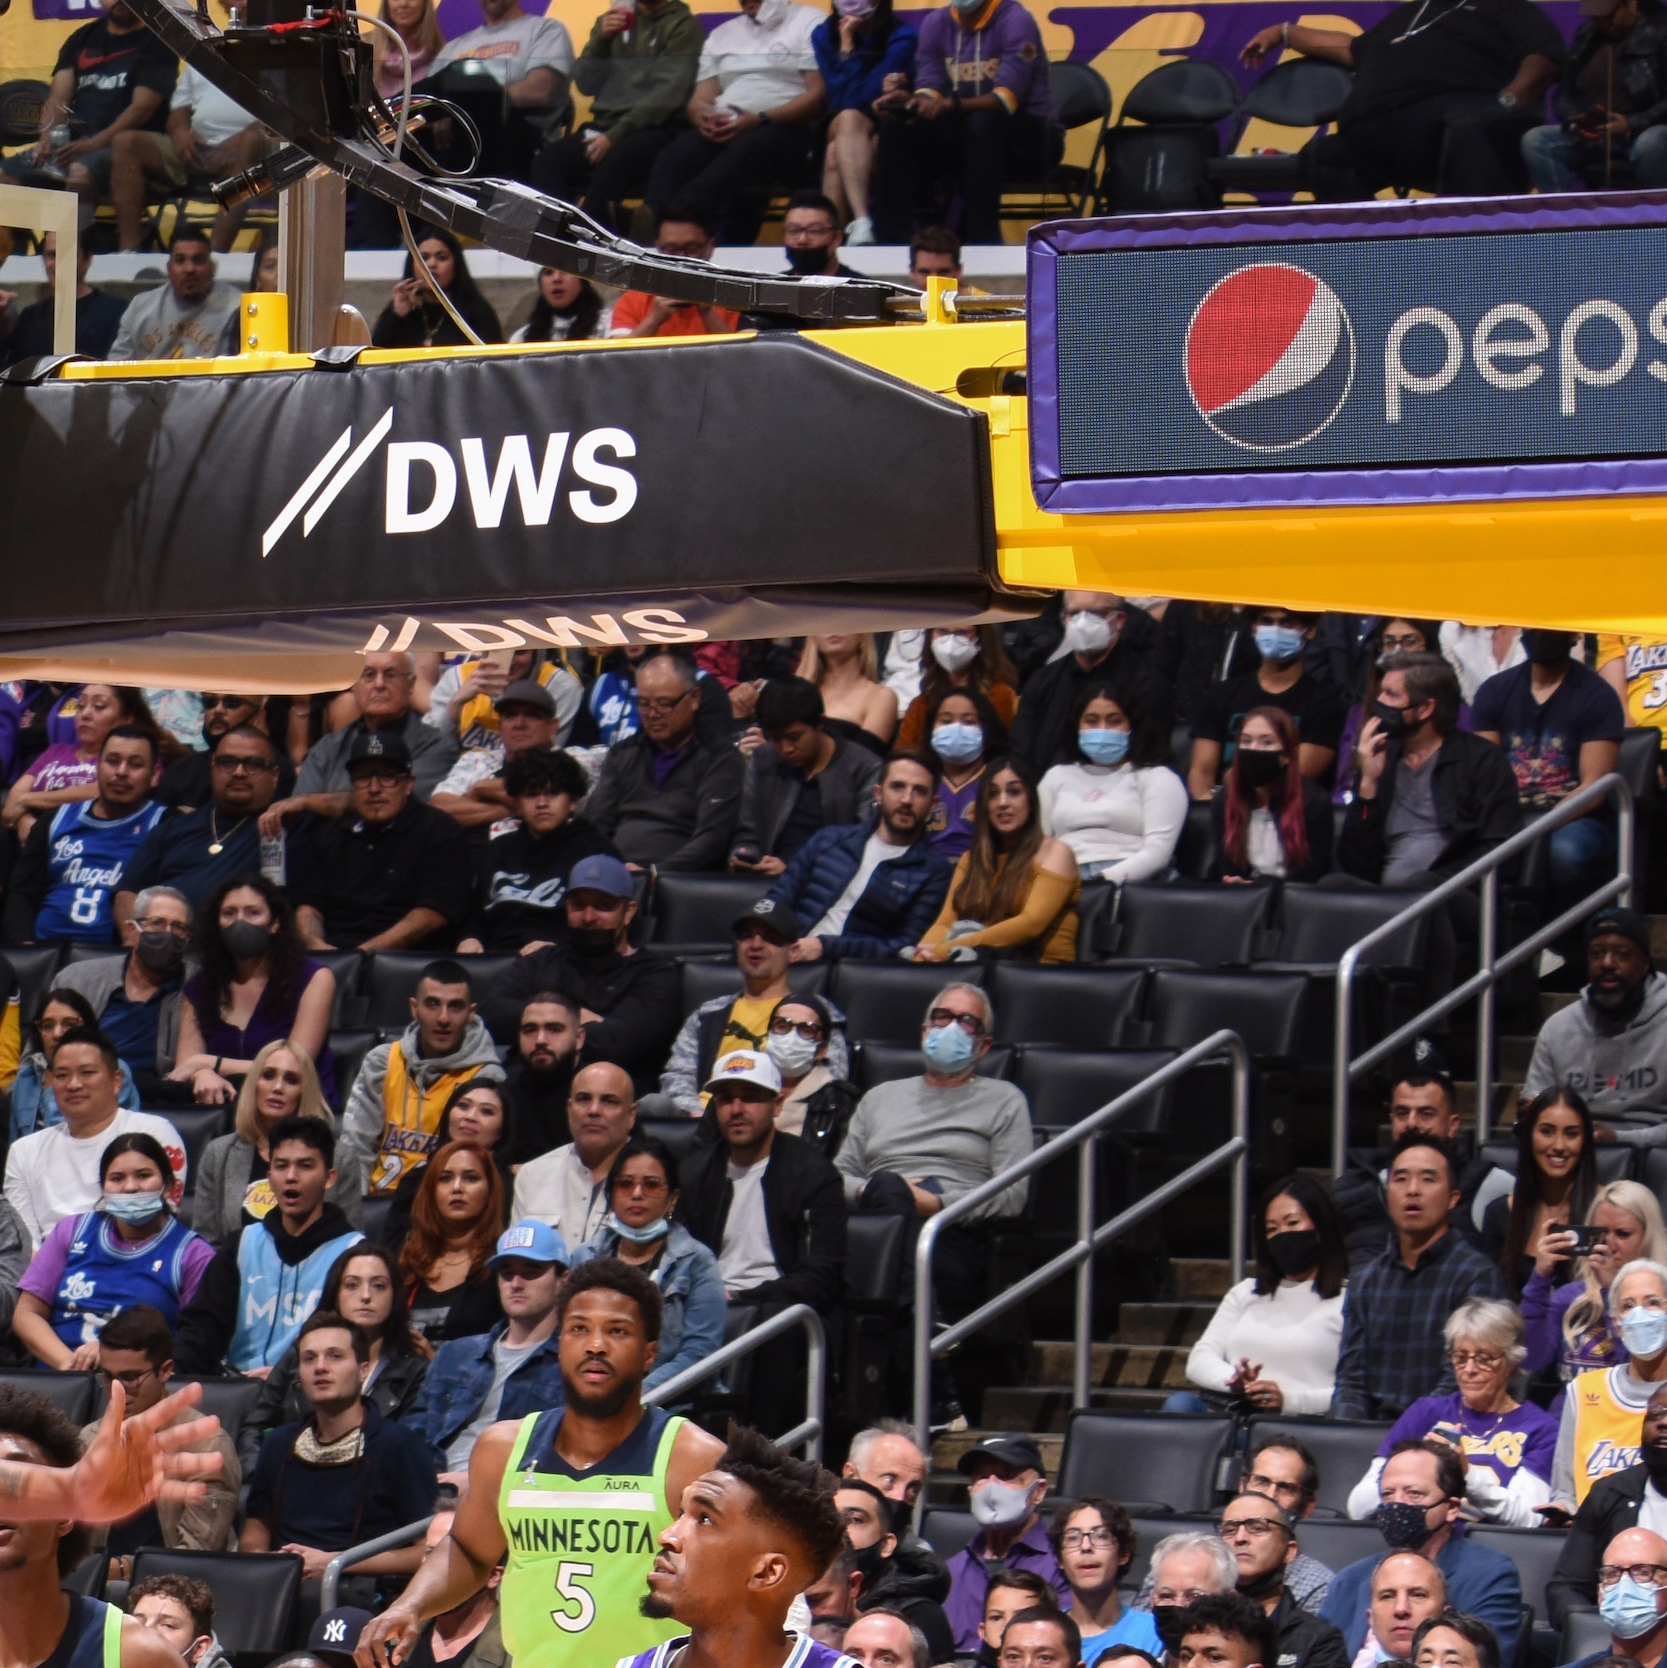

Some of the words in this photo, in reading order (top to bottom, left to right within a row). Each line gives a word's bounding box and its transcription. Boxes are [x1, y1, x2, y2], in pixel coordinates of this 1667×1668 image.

[385, 427, 639, 535] DWS
[433, 607, 710, 651] DWS
[52, 838, 81, 863] Los
[61, 861, 122, 887] Angel
[68, 887, 94, 924] 8
[380, 1130, 437, 1153] LAKER
[59, 1272, 95, 1300] Los
[510, 1517, 653, 1555] MINNESOTA
[551, 1560, 596, 1633] 5
[323, 1619, 347, 1642] NY
